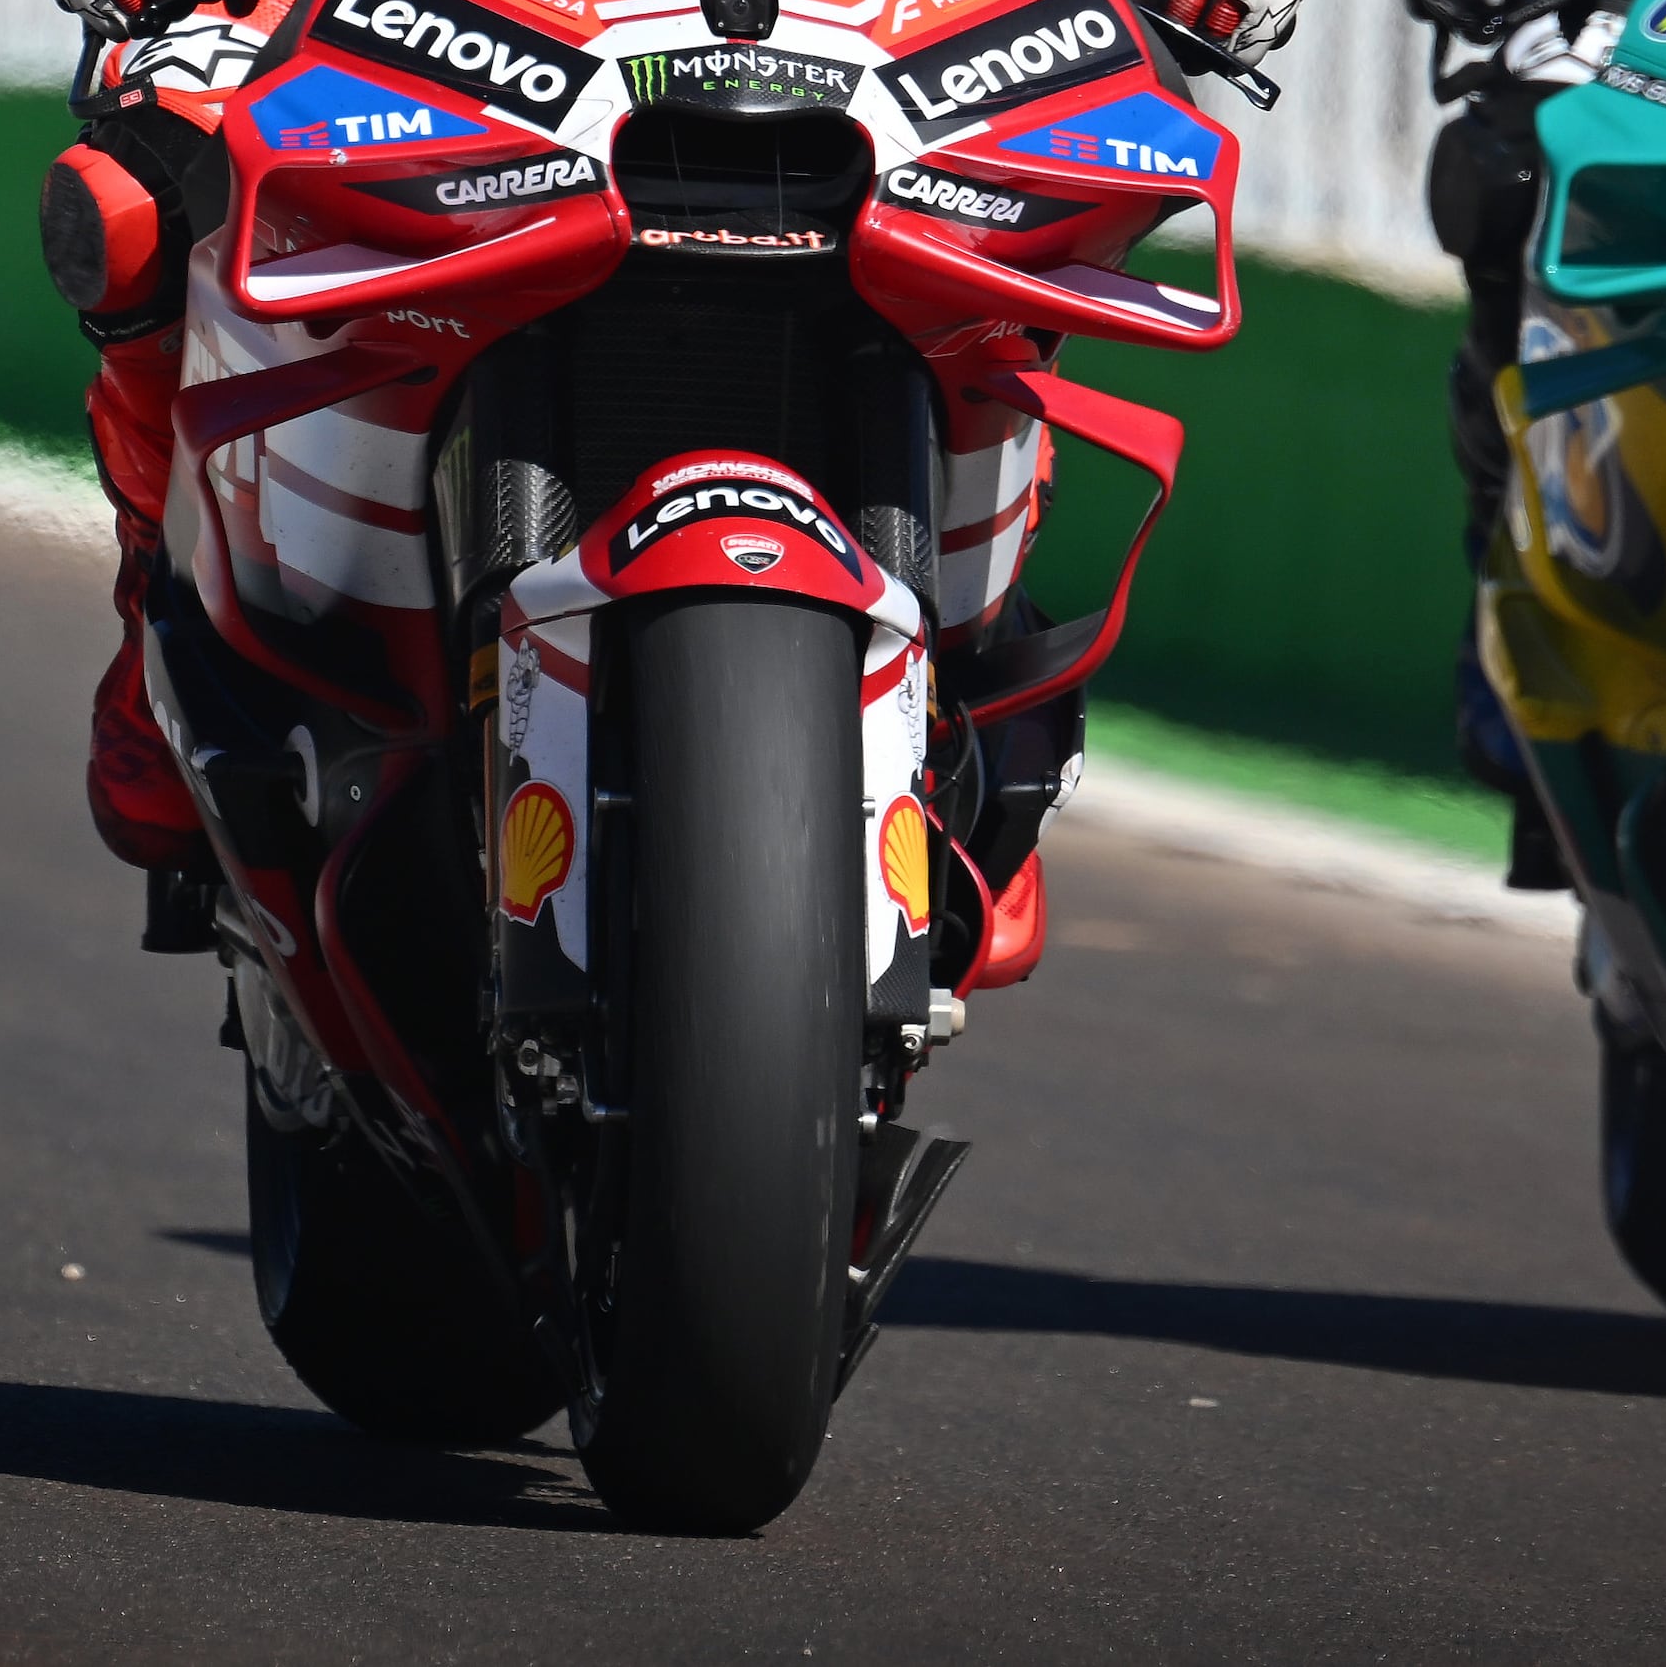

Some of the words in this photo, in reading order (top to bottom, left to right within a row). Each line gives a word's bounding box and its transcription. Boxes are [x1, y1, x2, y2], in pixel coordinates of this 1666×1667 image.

[898, 8, 1118, 121] Lenovo
[702, 78, 827, 102] ENERGY
[335, 108, 433, 144] TIM
[1106, 138, 1200, 177] TIM
[436, 156, 597, 207] CARRERA
[887, 167, 1027, 225] CARRERA
[639, 227, 827, 250] aruba.it
[627, 485, 848, 555] Lenovo
[727, 537, 779, 551] DUCATI
